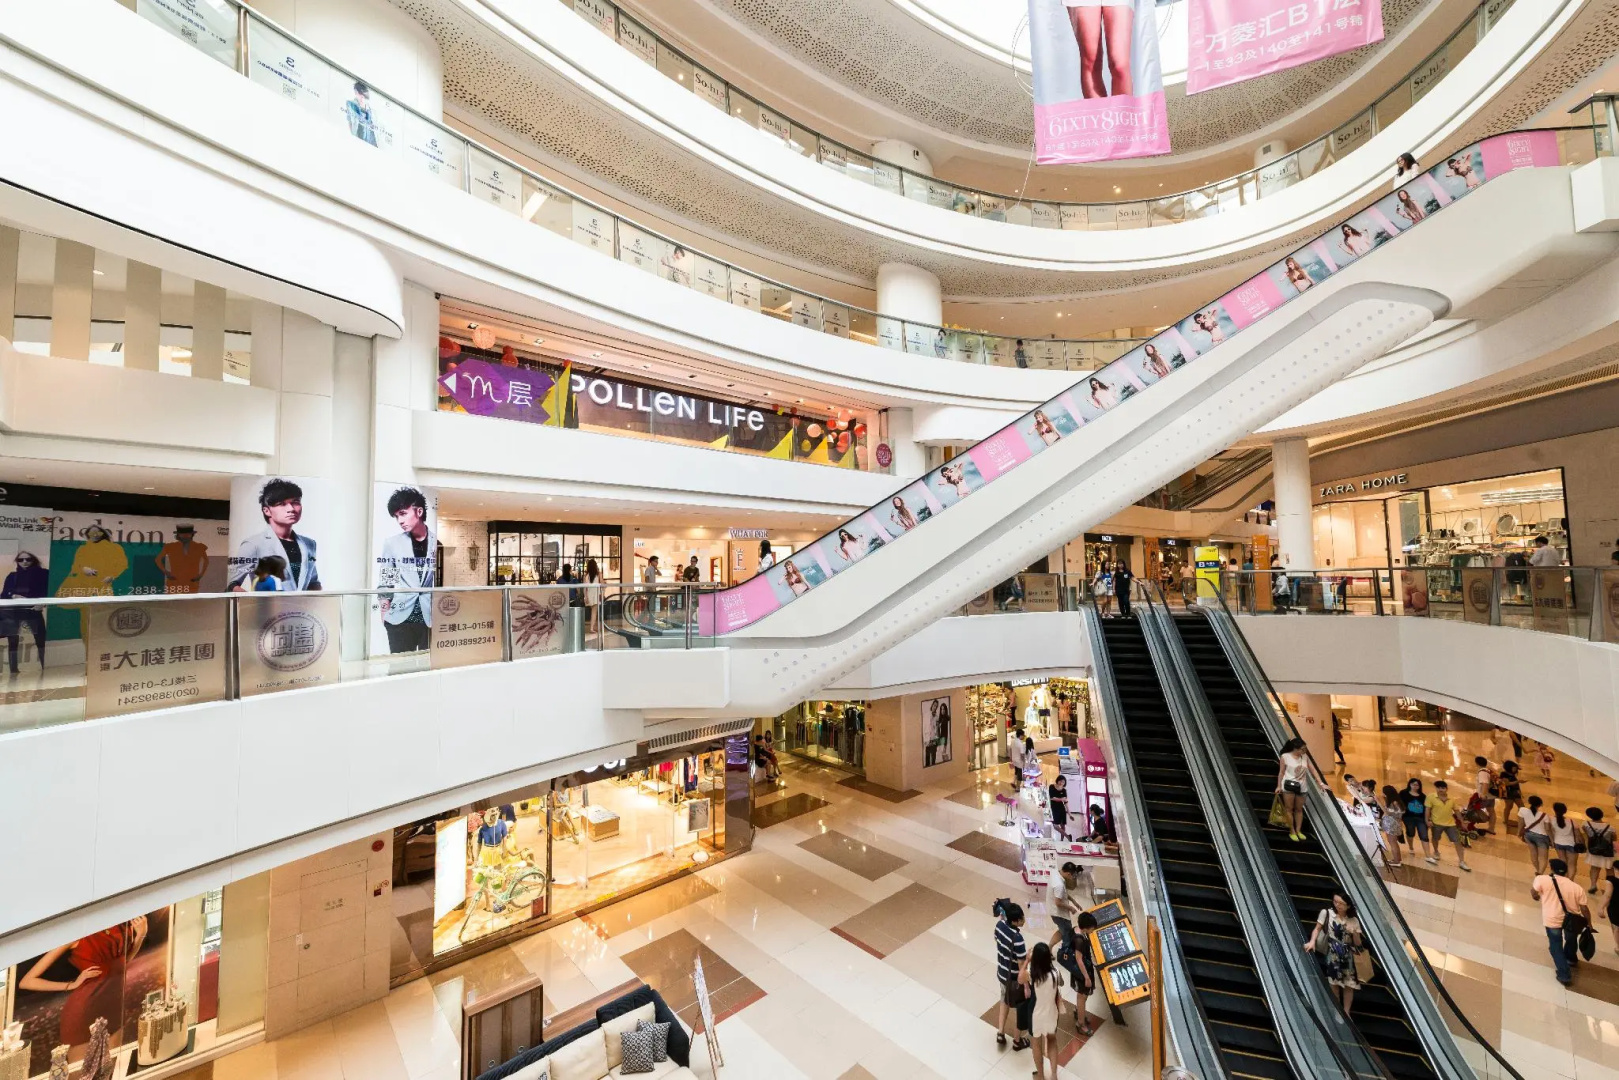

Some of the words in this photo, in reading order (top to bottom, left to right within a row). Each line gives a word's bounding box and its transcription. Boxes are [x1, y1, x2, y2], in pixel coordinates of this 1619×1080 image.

[1320, 483, 1355, 498] ZARA
[1361, 473, 1409, 490] HOME
[128, 585, 190, 595] 2838-3888
